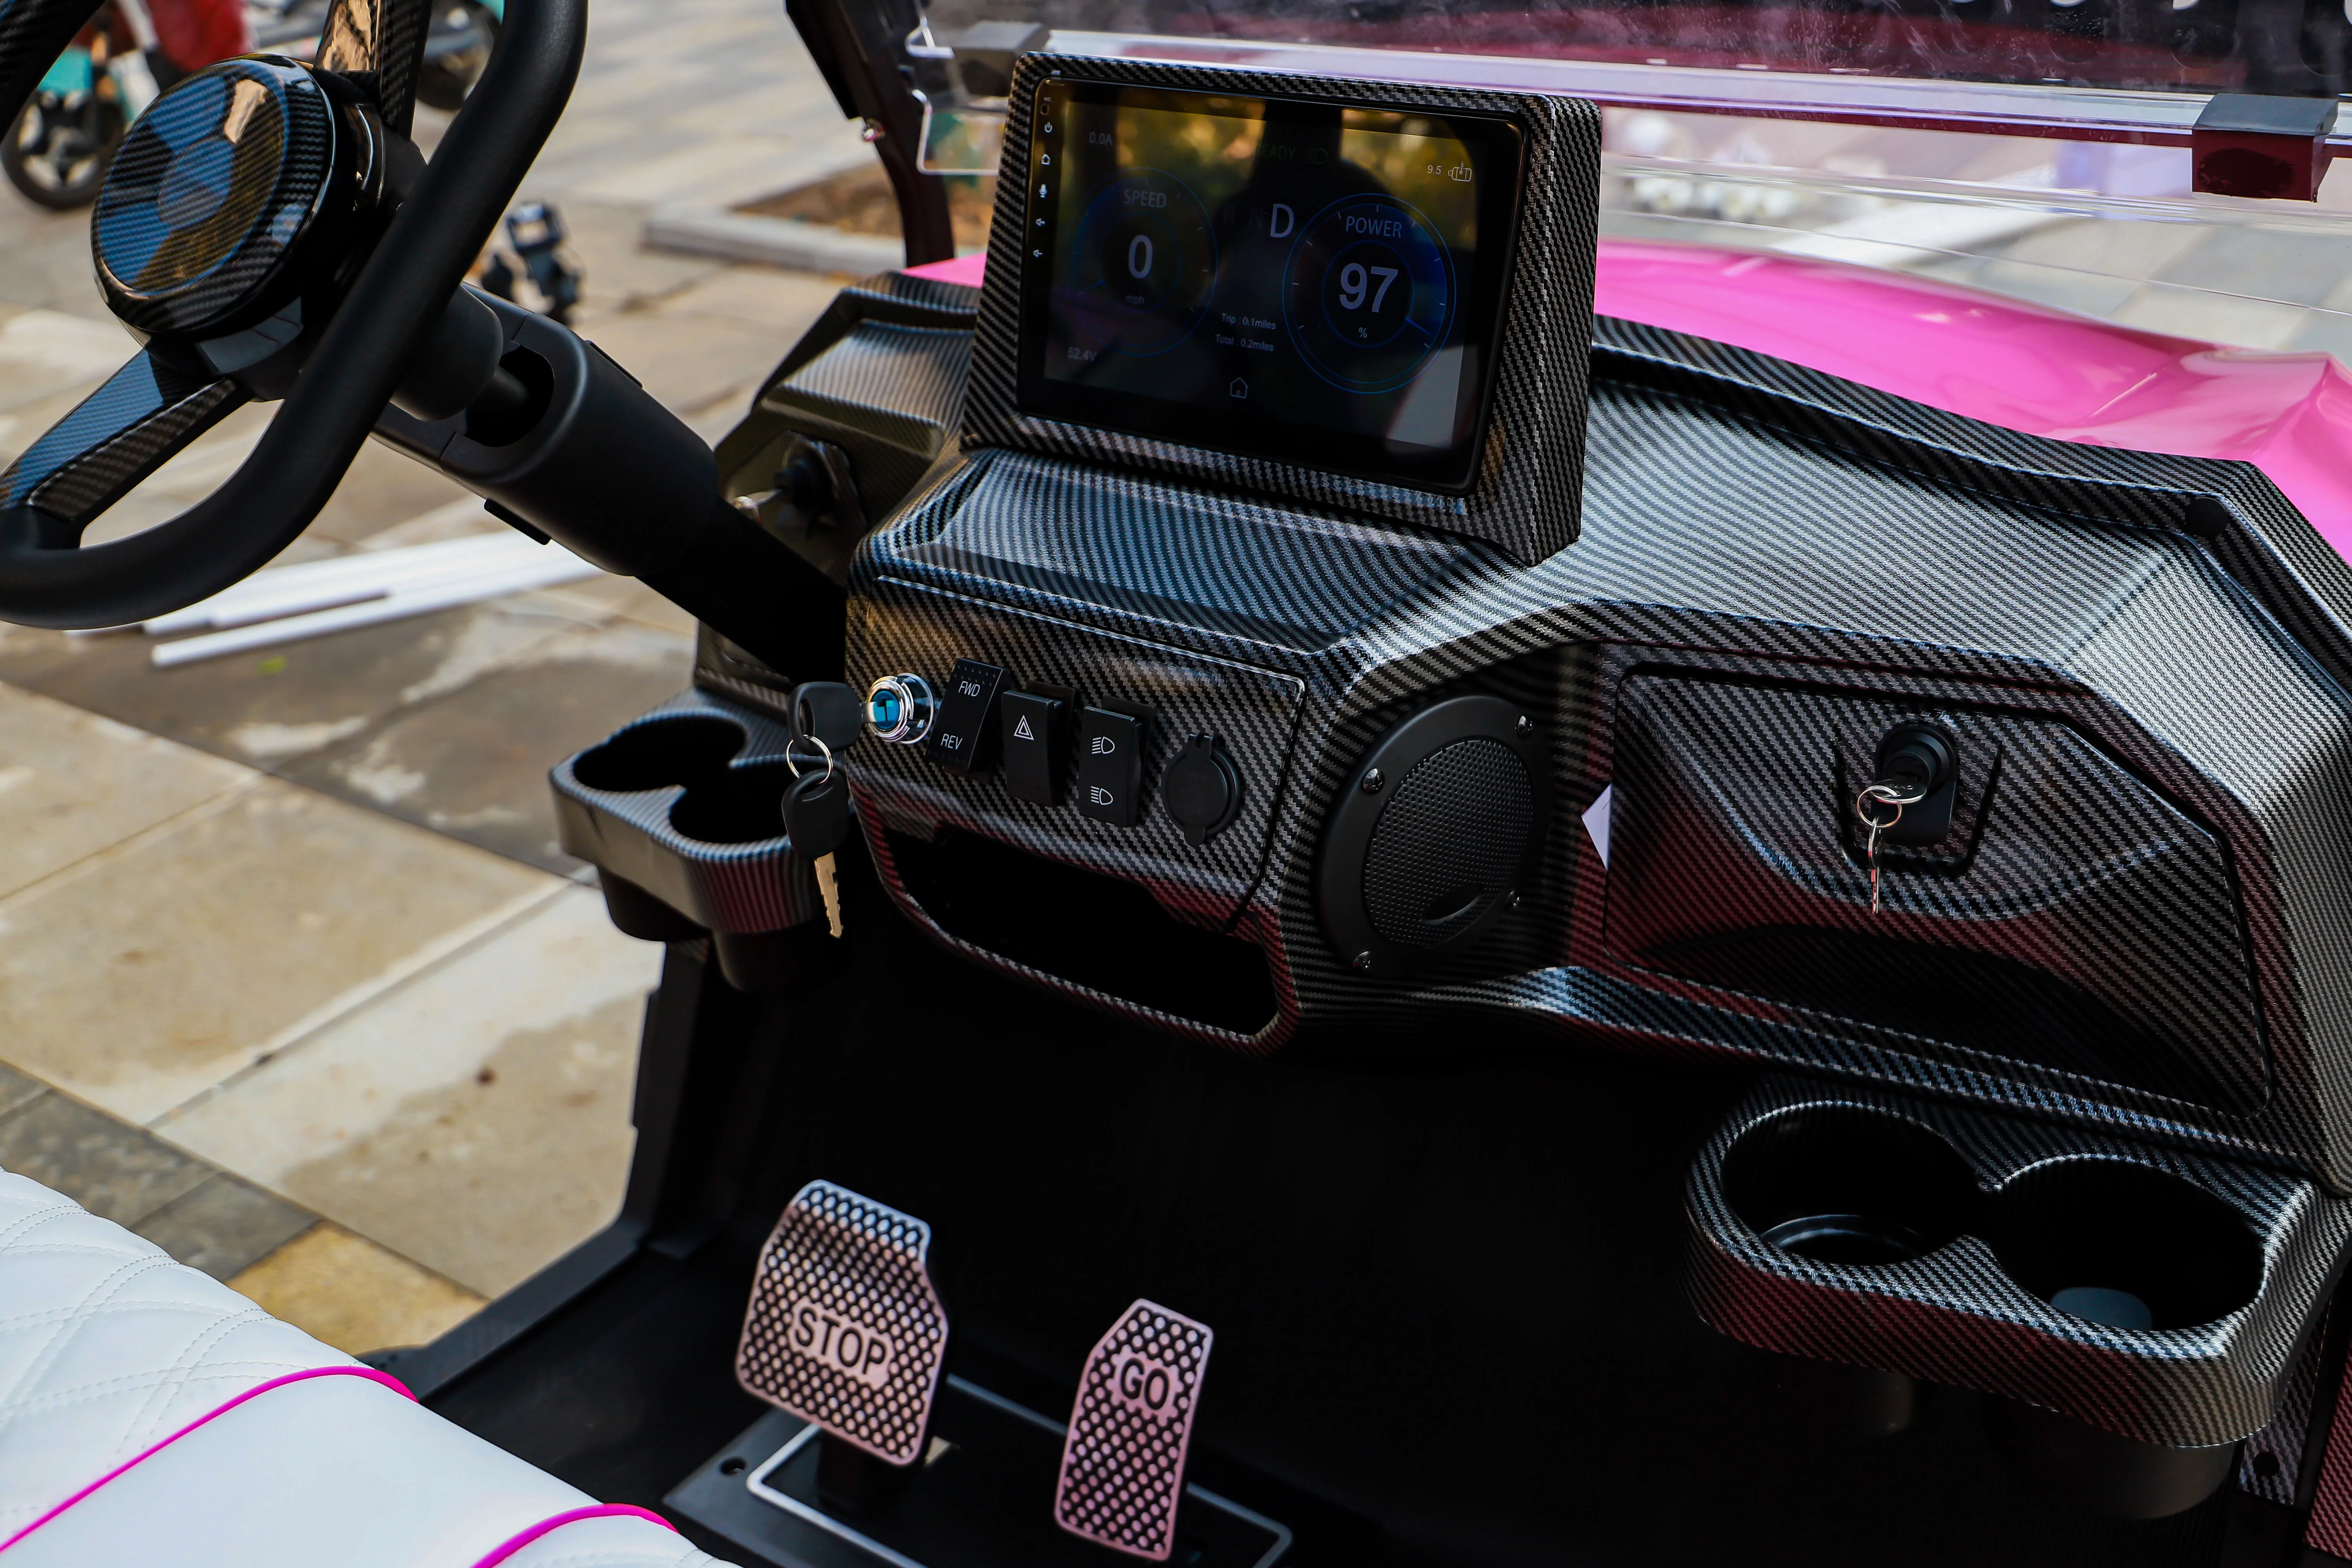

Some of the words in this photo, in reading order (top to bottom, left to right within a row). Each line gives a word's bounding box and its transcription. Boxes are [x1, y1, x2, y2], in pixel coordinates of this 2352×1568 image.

[1089, 132, 1113, 146] 0.0A
[1427, 165, 1441, 175] 9.5
[1124, 189, 1166, 208] SPEED
[1270, 203, 1294, 238] D
[1346, 216, 1402, 238] POWER
[1128, 234, 1152, 278] 0
[1339, 263, 1398, 312] 97
[1126, 294, 1145, 305] mph
[1358, 327, 1367, 338] %
[958, 680, 980, 698] FWD
[940, 733, 963, 750] REV
[794, 1305, 888, 1376] STOP
[1120, 1357, 1169, 1411] GO
